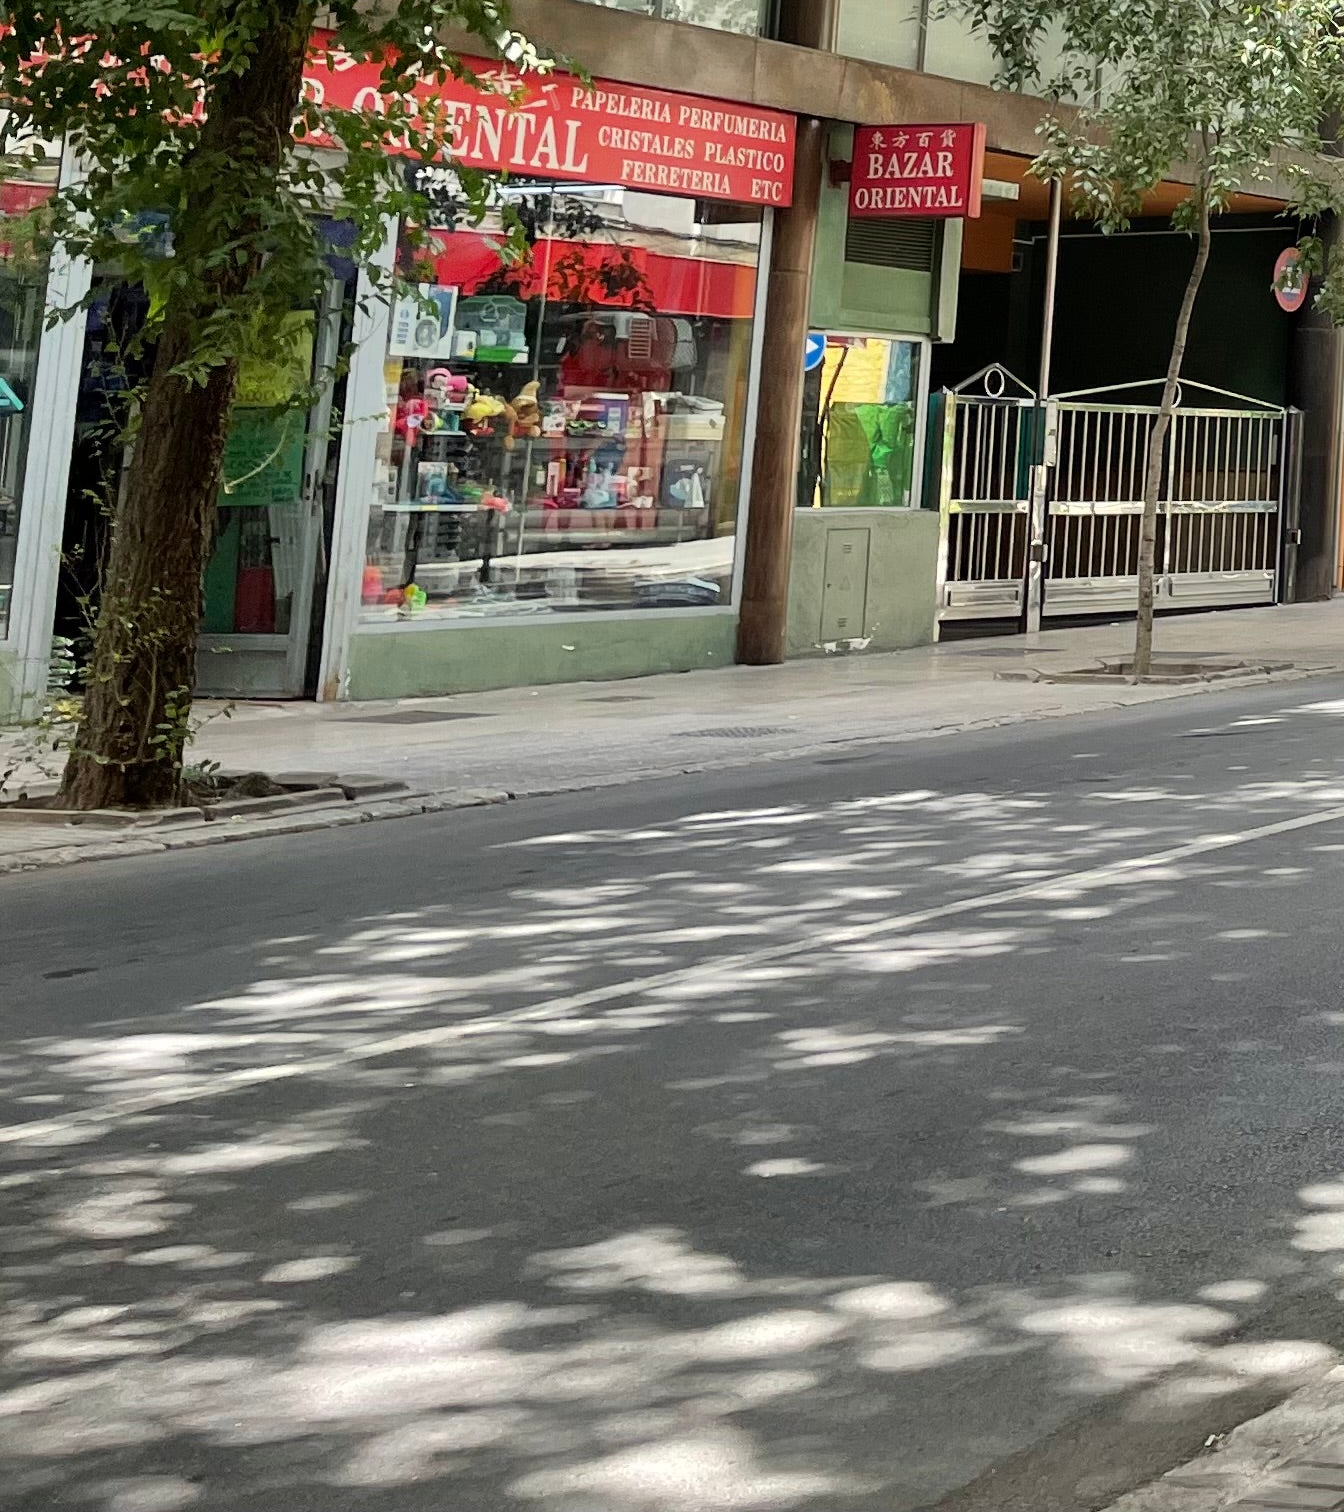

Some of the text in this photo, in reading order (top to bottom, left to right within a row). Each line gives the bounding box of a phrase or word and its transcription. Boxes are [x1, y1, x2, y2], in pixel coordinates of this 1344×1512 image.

[570, 87, 786, 143] PAPELERIA PERFUMERIA
[598, 126, 784, 173] CRISTALES PLASTICO
[867, 151, 953, 179] BAZAR
[620, 159, 782, 201] FERRETERIA ETC
[855, 185, 962, 209] ORIENTAL
